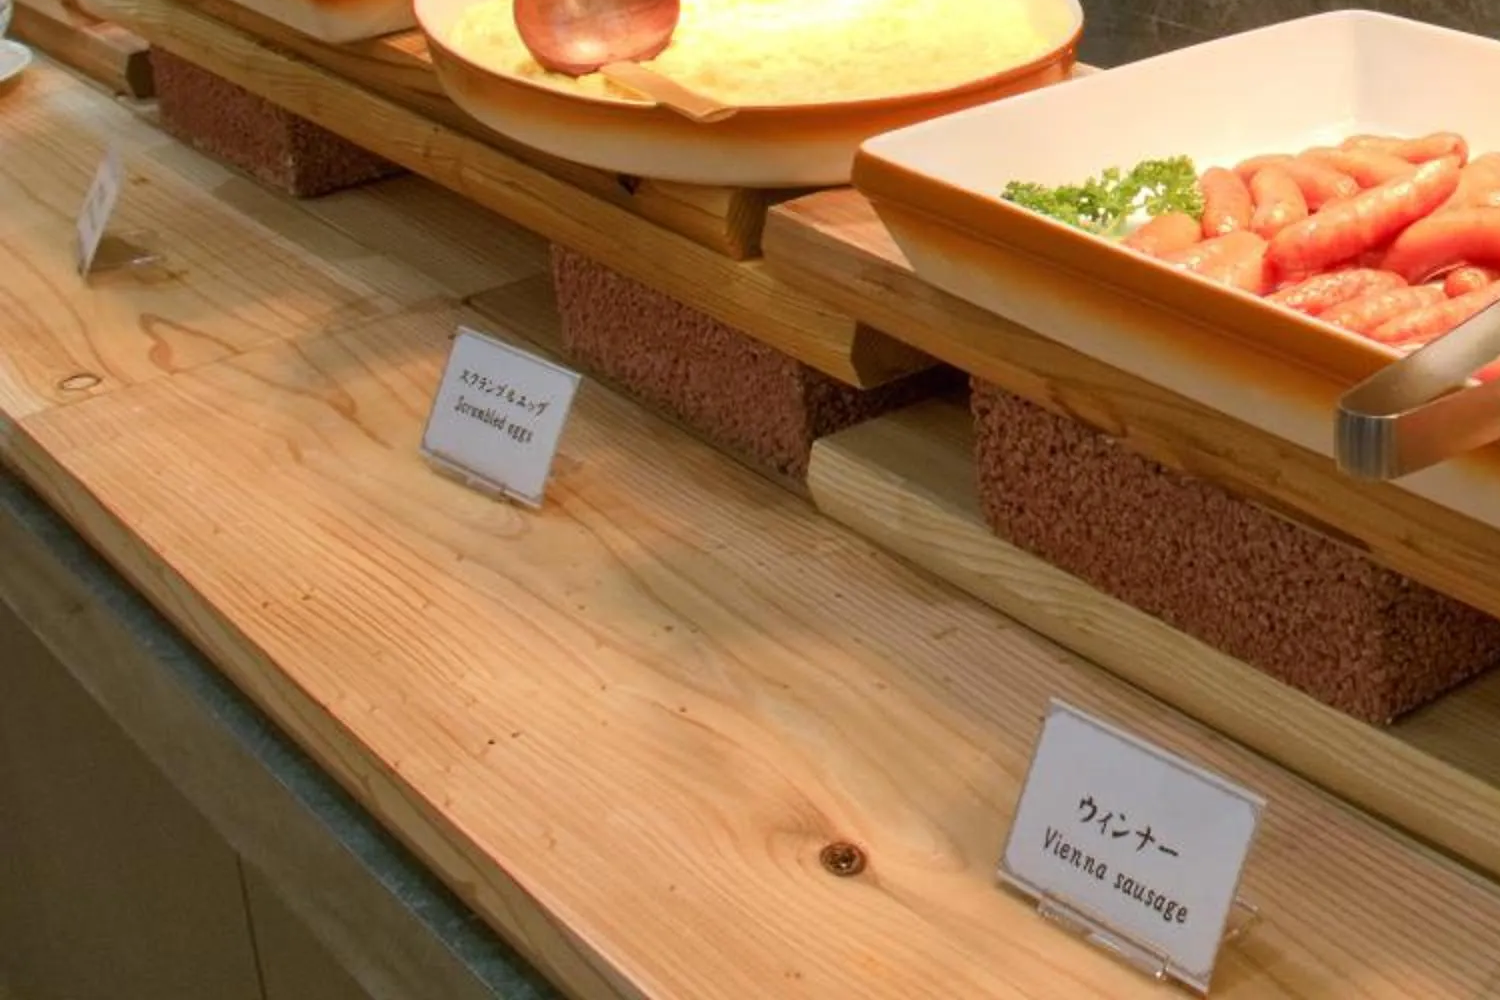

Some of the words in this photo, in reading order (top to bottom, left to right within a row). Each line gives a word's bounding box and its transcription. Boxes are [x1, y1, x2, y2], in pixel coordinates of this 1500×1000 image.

[454, 395, 506, 430] Scrambled
[507, 423, 533, 443] eggs
[1043, 826, 1107, 880] Vienna
[1113, 871, 1188, 924] sausage
